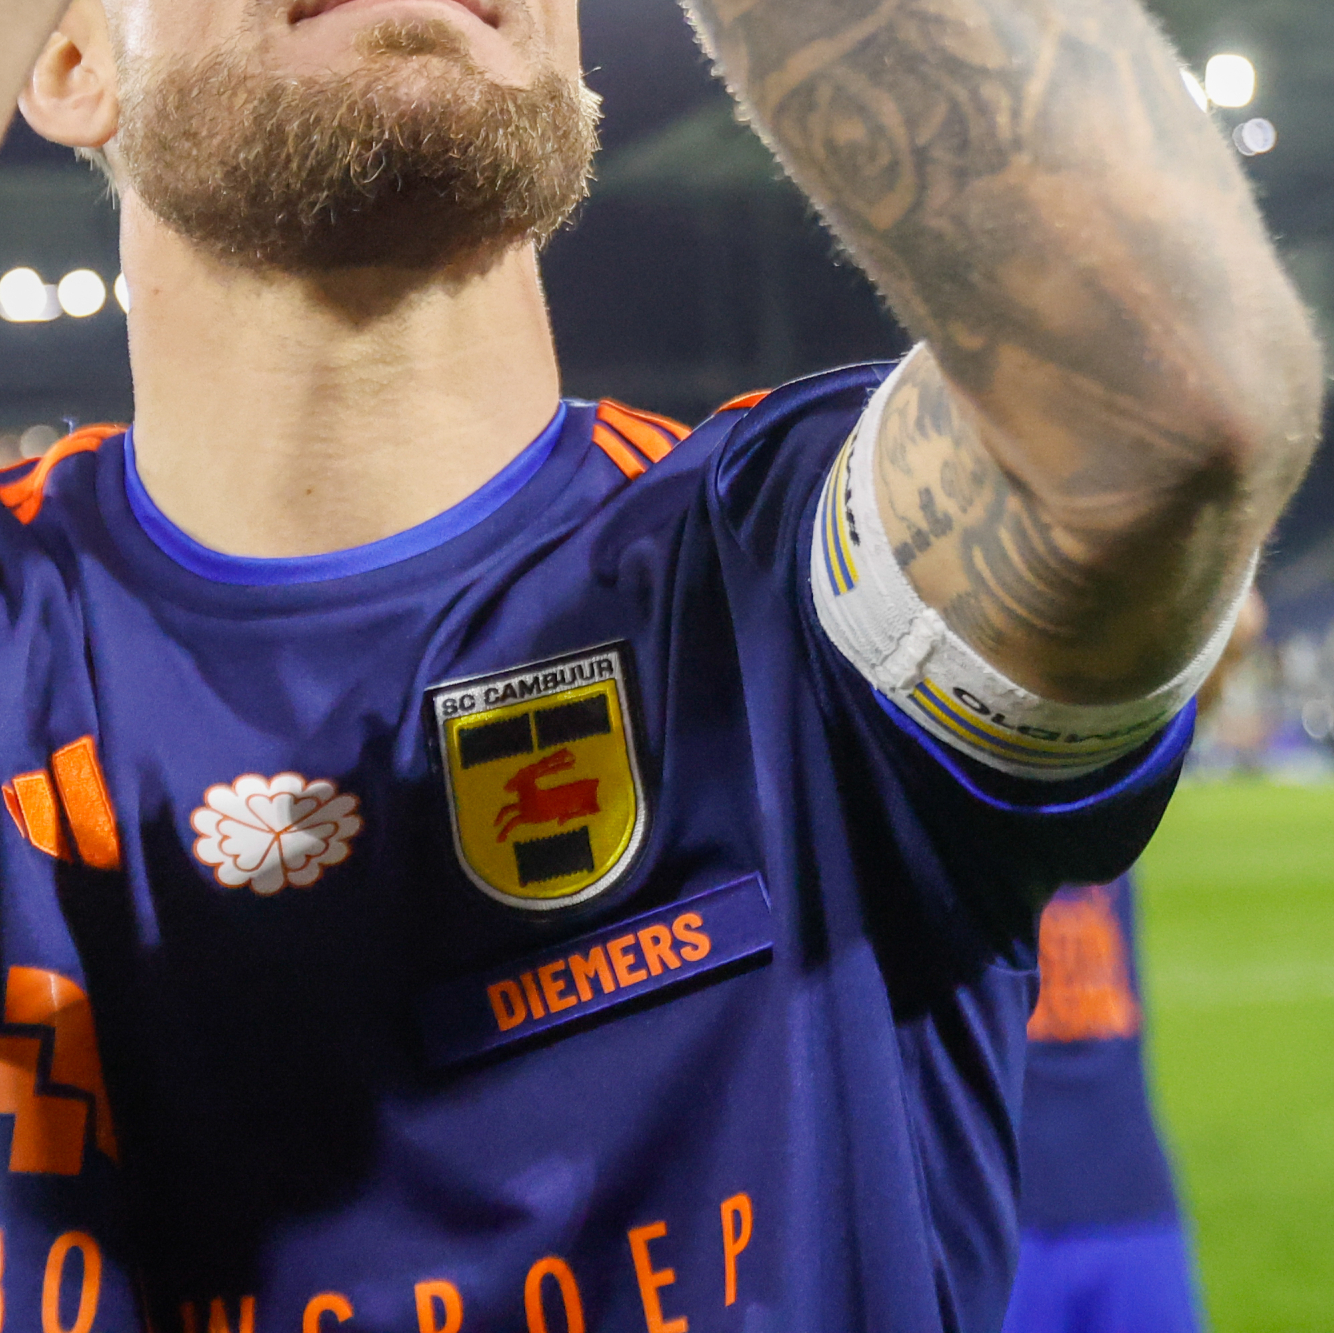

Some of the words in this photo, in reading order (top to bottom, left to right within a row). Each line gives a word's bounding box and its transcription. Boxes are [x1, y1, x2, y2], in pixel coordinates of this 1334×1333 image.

[441, 693, 476, 717] SC
[483, 658, 614, 706] CAMBUUR
[486, 911, 712, 1032] DIEMERS
